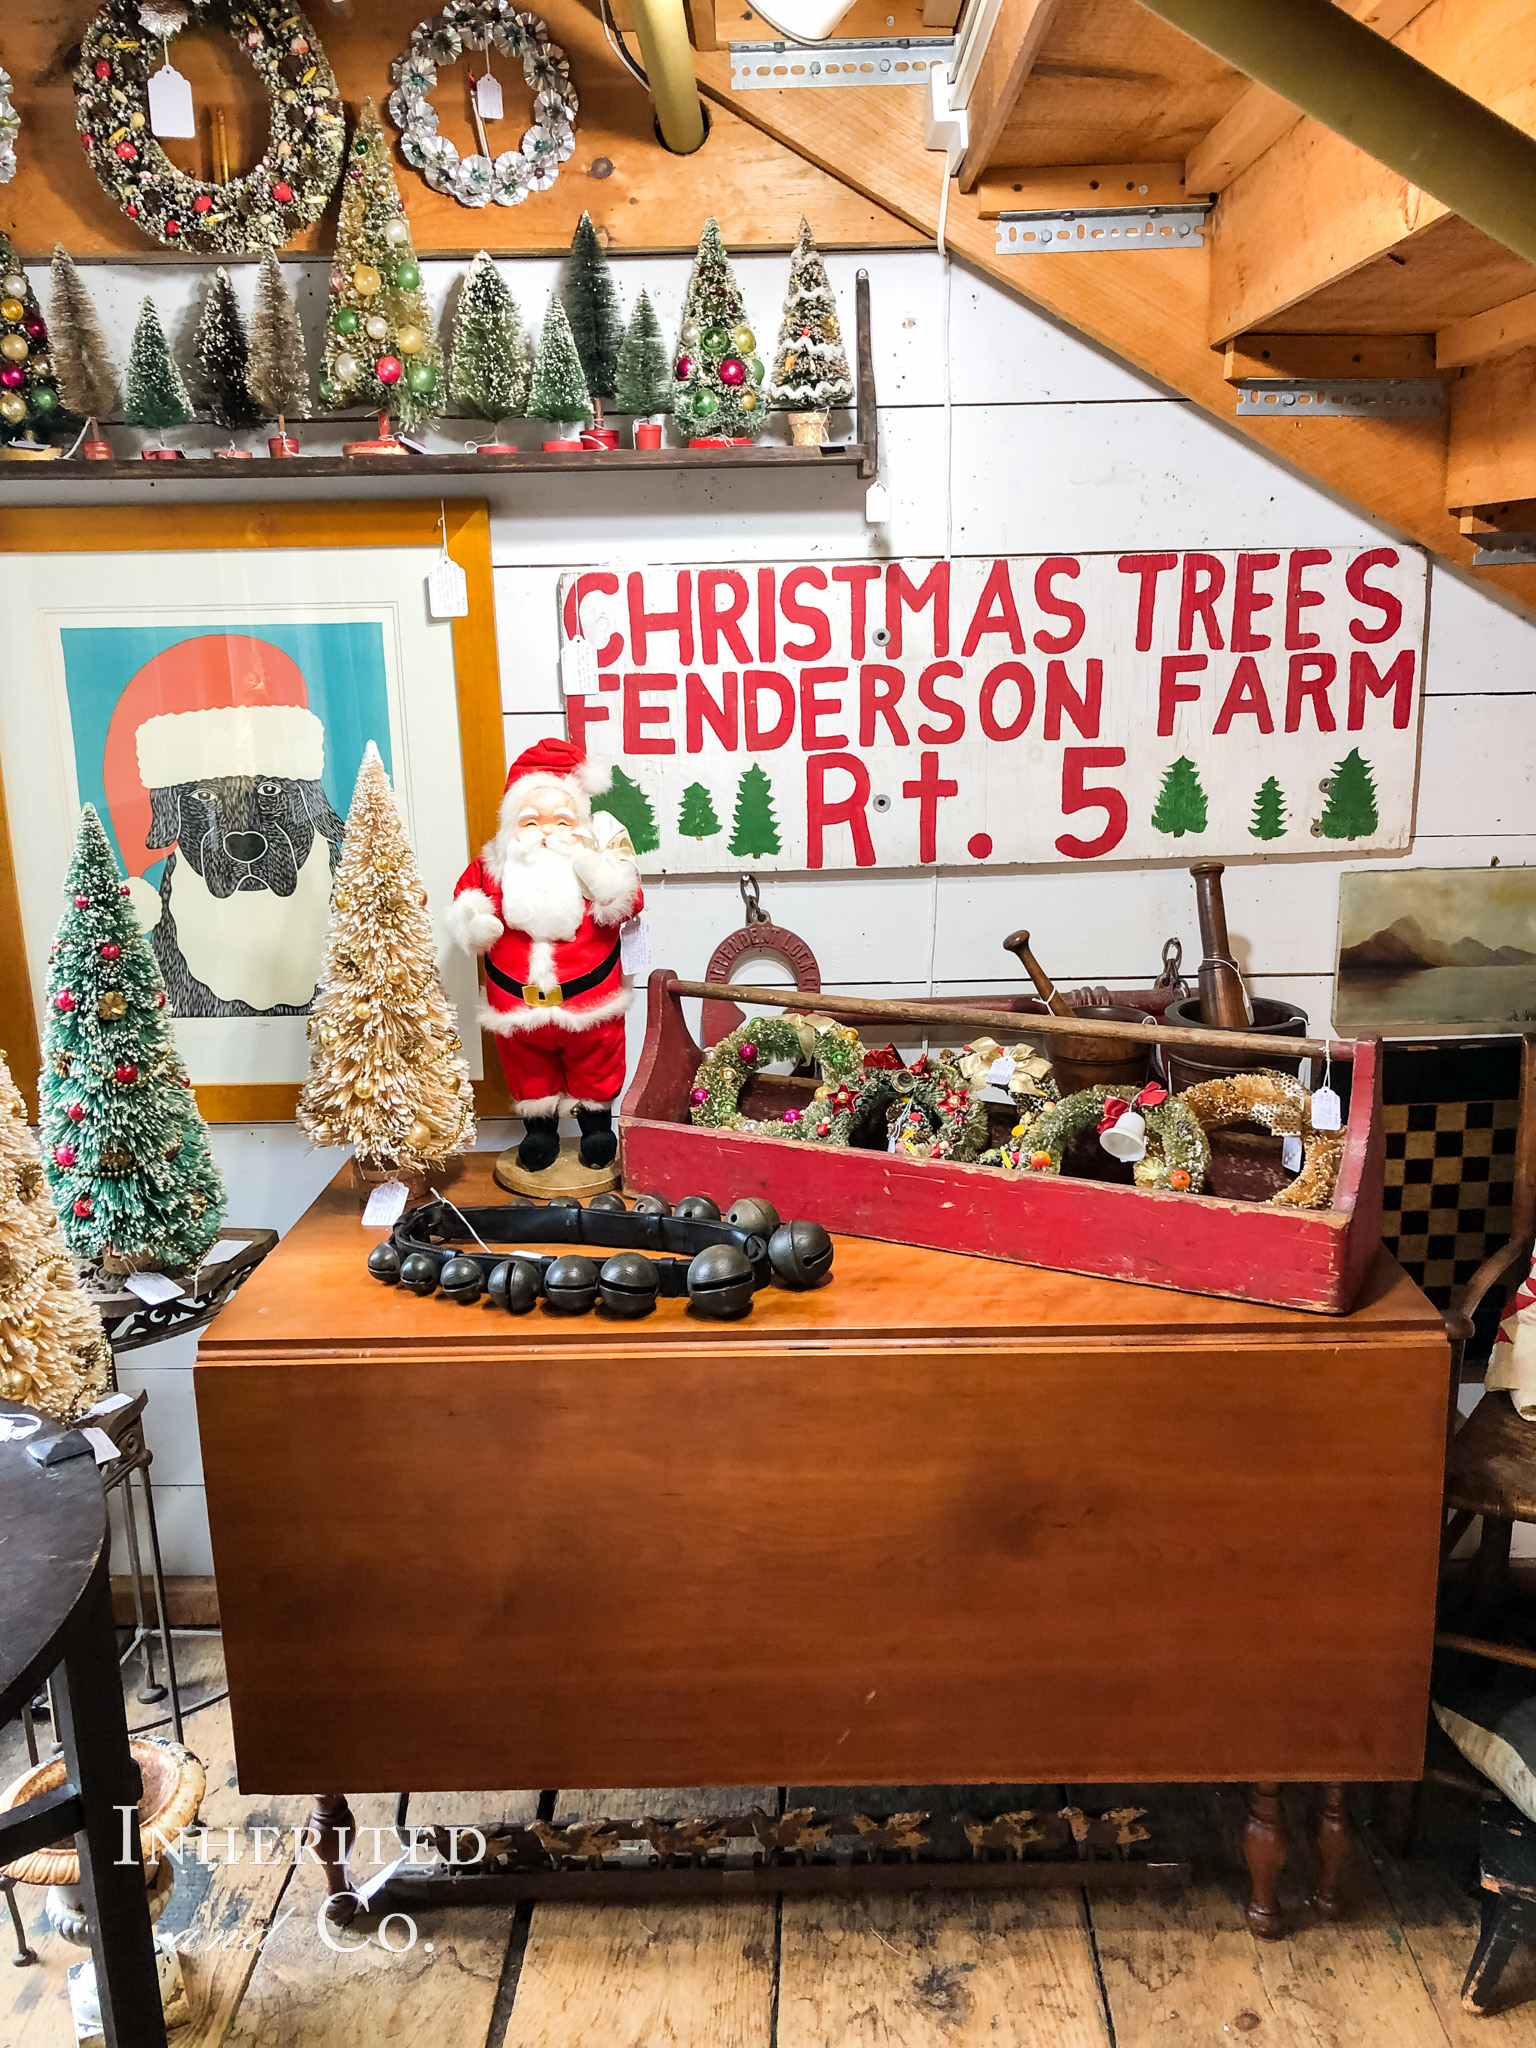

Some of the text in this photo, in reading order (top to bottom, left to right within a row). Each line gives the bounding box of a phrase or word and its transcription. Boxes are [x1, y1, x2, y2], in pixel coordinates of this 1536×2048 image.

[564, 556, 1086, 669] CHRISTMAS
[1117, 547, 1403, 653] TREES
[566, 658, 1103, 755] FENDERSON
[1156, 649, 1416, 737] FARM
[806, 746, 1128, 869] Rt. 5
[781, 933, 817, 974] LOCK
